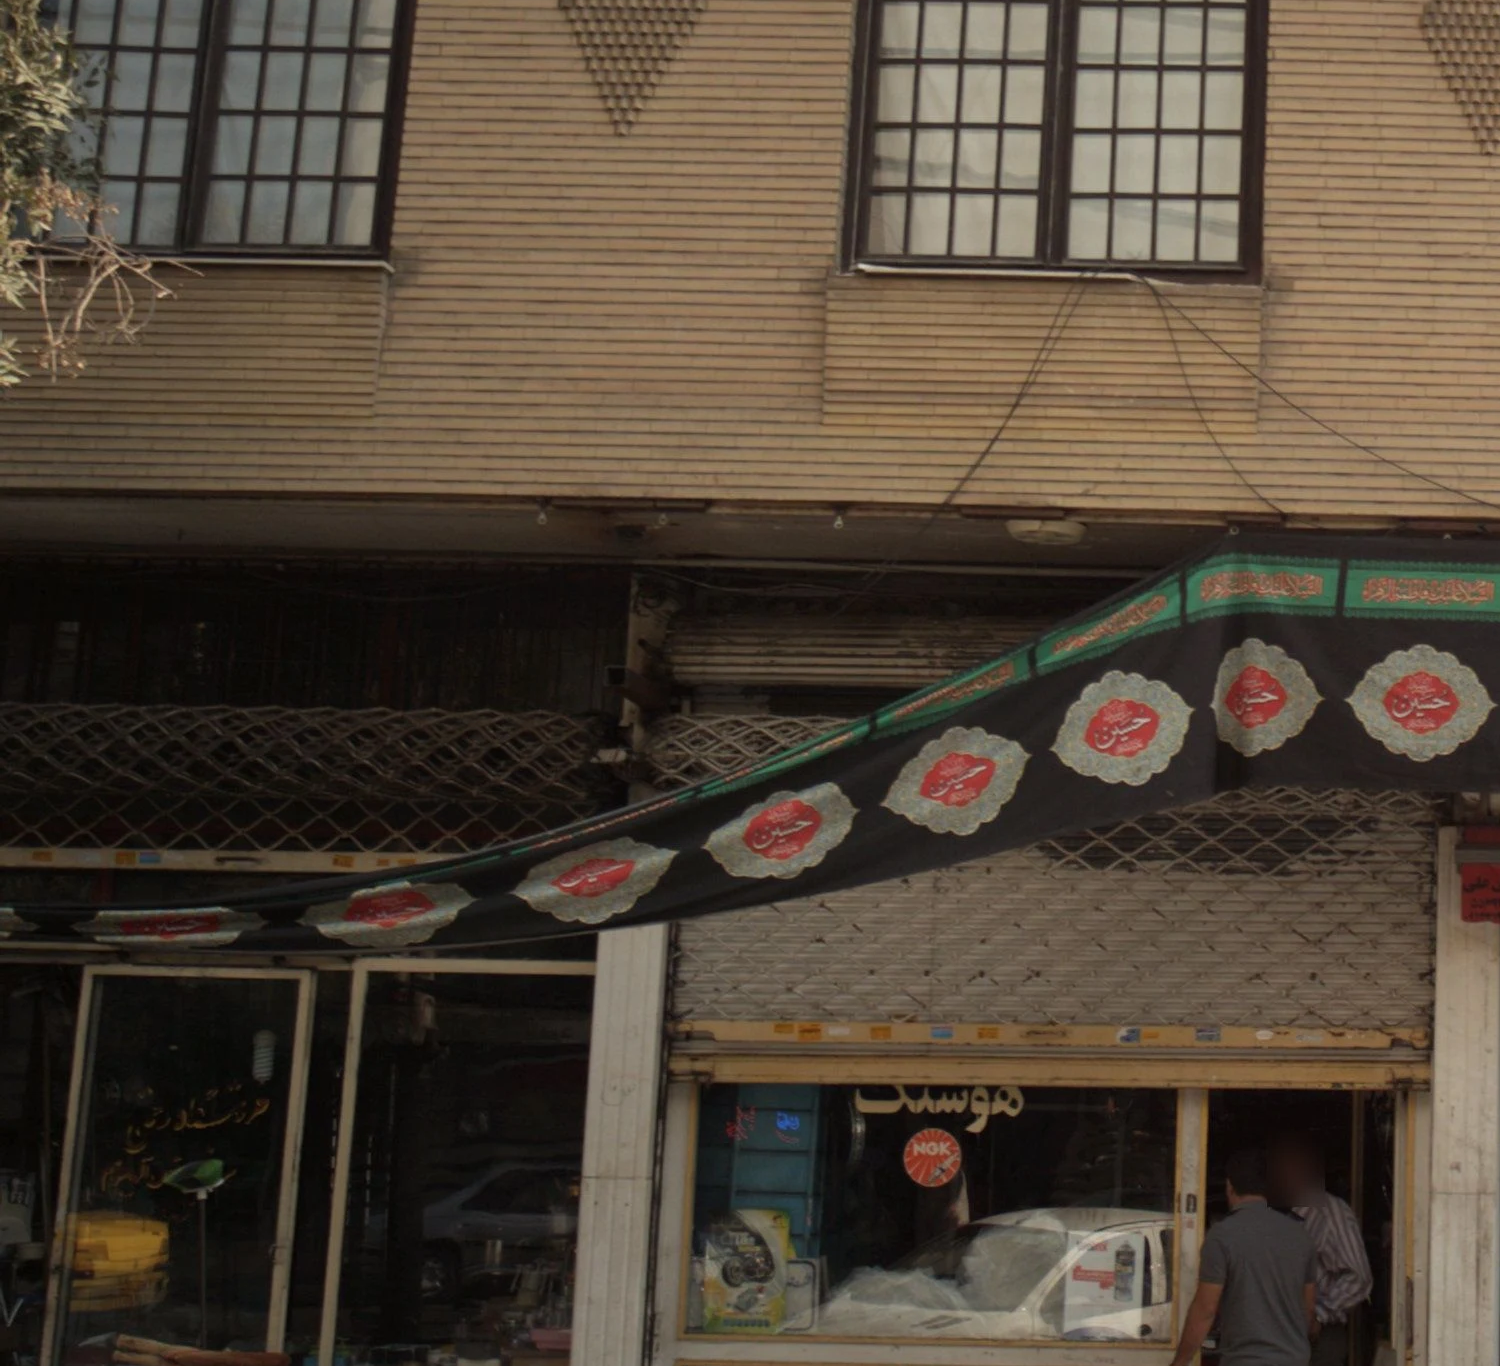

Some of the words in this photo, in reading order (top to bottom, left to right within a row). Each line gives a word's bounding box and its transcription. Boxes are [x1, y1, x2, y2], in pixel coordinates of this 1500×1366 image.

[1392, 691, 1450, 718] حسین
[1096, 714, 1151, 749] حسین
[752, 819, 813, 850] حسین
[913, 1141, 953, 1156] NGK
